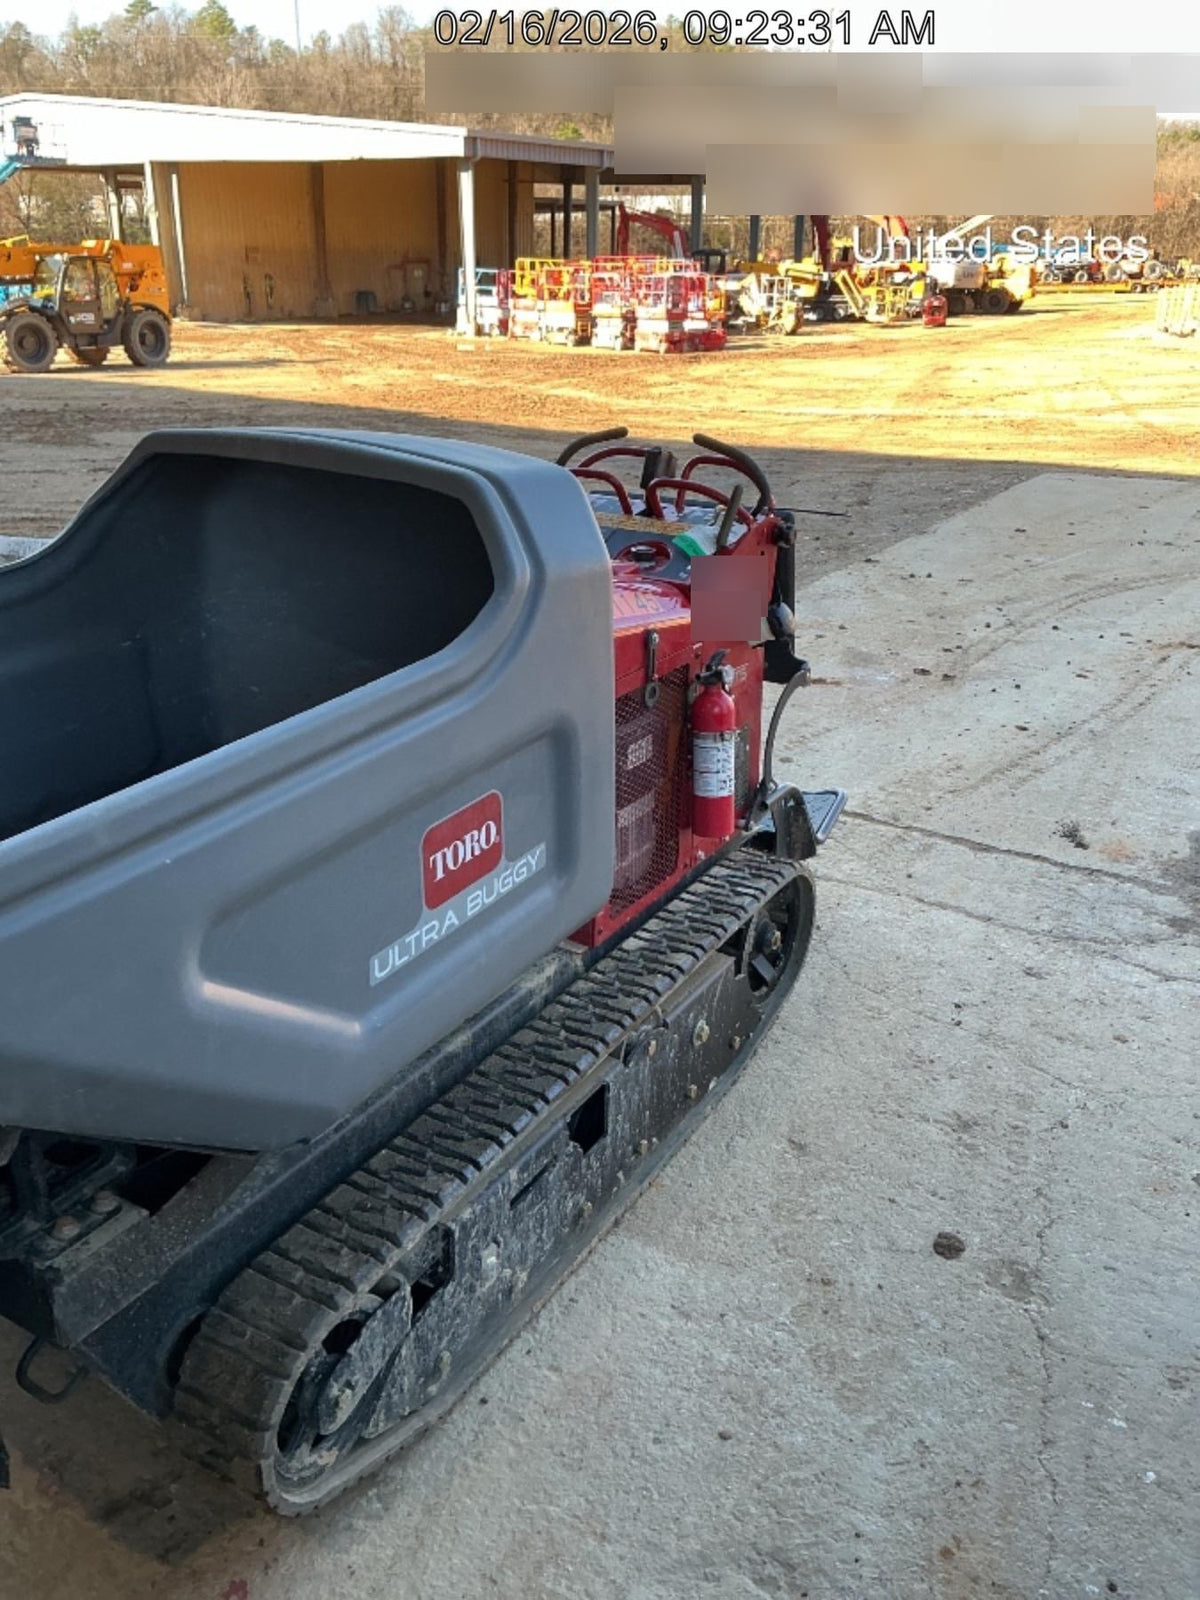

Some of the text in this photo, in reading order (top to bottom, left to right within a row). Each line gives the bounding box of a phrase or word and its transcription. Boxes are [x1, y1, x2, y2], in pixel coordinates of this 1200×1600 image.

[429, 820, 498, 882] TORO
[373, 848, 542, 979] ULTRA BUGGY
